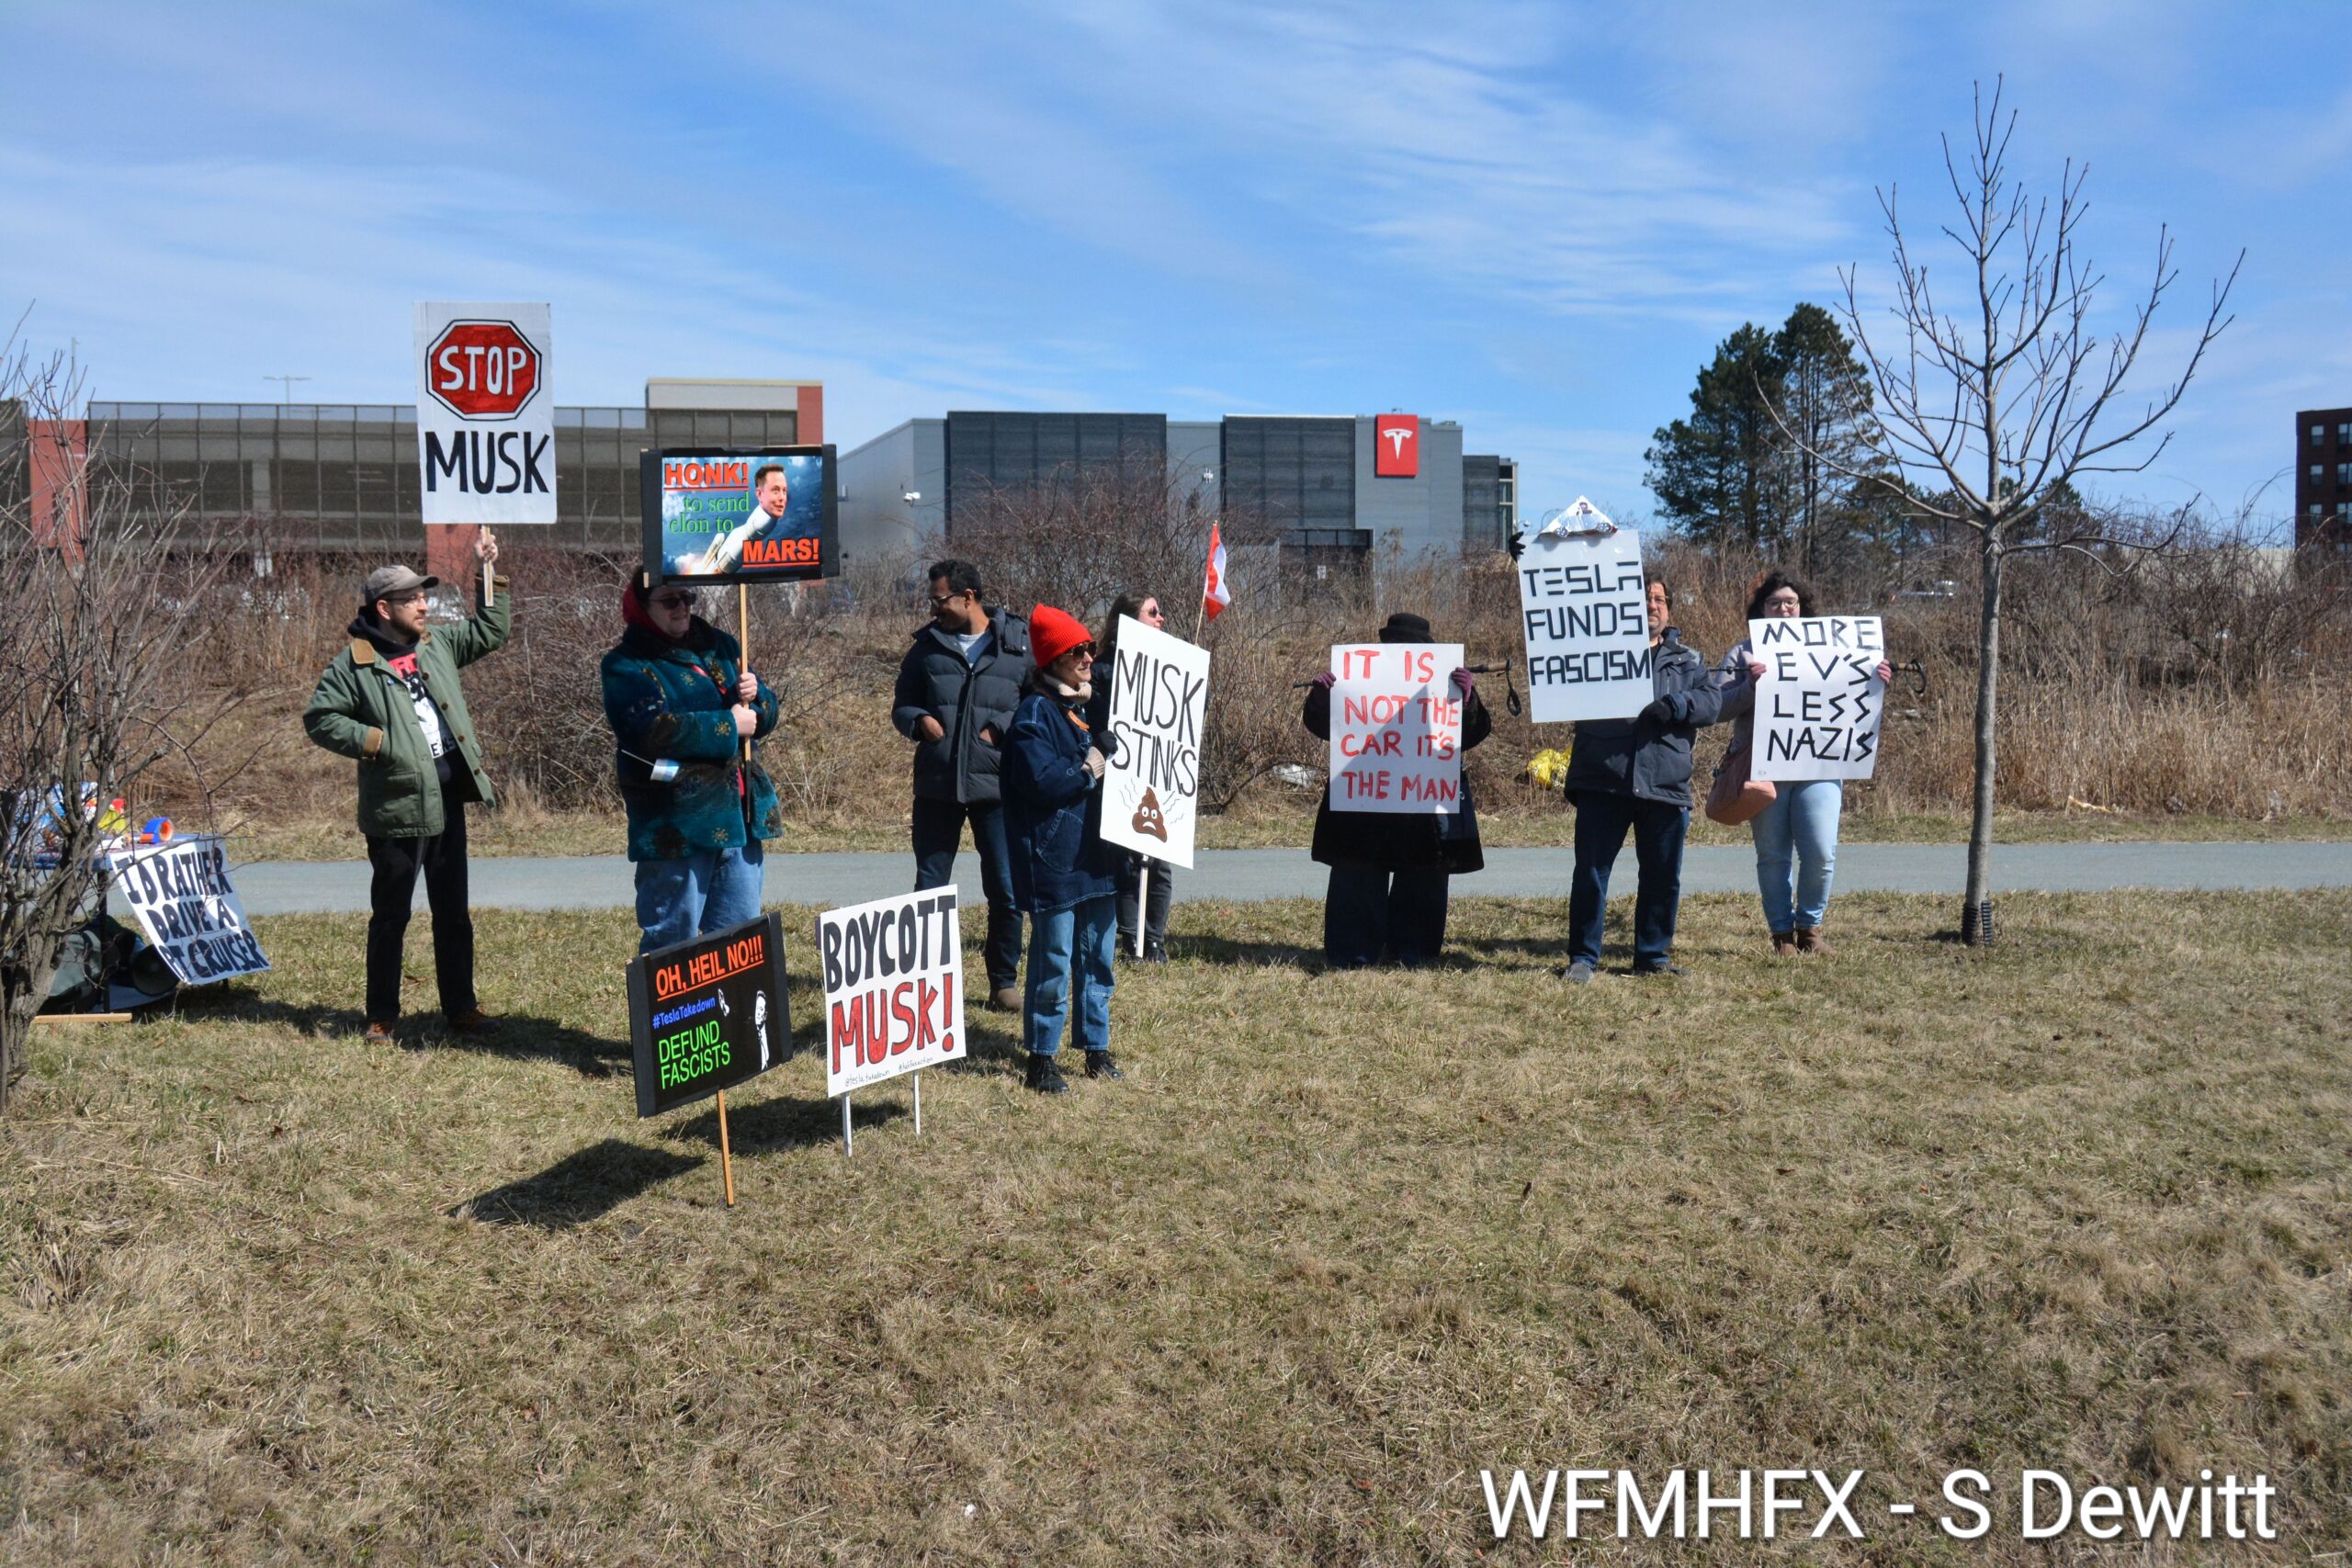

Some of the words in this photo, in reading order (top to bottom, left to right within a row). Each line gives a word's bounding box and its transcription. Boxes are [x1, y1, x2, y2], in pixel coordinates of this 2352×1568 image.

[438, 345, 527, 396] STOP
[424, 431, 550, 494] MUSK
[663, 462, 750, 487] HONK!
[684, 496, 703, 513] to
[708, 491, 750, 513] send
[669, 512, 710, 534] elon
[716, 517, 734, 534] to
[742, 538, 820, 563] MARS!
[1522, 560, 1643, 597] TESLA
[1525, 602, 1644, 641] FUNDS
[1762, 618, 1882, 649] MORE
[1343, 649, 1380, 681] IT
[1404, 650, 1434, 683] IS
[1529, 649, 1651, 686] FASCISM
[1113, 649, 1204, 748] MUSK
[1343, 694, 1410, 726] NOT
[1417, 696, 1461, 727] THE
[1773, 690, 1871, 724] LESS
[1112, 720, 1197, 797] STINKS
[1340, 730, 1404, 758] CAR
[1417, 731, 1455, 761] IT'S
[1767, 727, 1875, 762] NAZIS
[1341, 770, 1391, 800] THE
[1400, 773, 1458, 802] MAN
[153, 847, 233, 901] RATHER
[146, 900, 214, 943] DRIVE
[217, 898, 237, 930] A
[158, 944, 193, 981] PT
[187, 929, 271, 978] CRUISER
[823, 895, 956, 994] BOYCOTT
[656, 964, 687, 994] OH,
[688, 951, 726, 986] HEIL
[727, 935, 764, 968] NO!!!
[652, 997, 716, 1029] #TeslaTakedown
[832, 972, 955, 1076] MUSK!
[659, 1021, 720, 1064] DEFUND
[661, 1042, 730, 1089] FASCISTS
